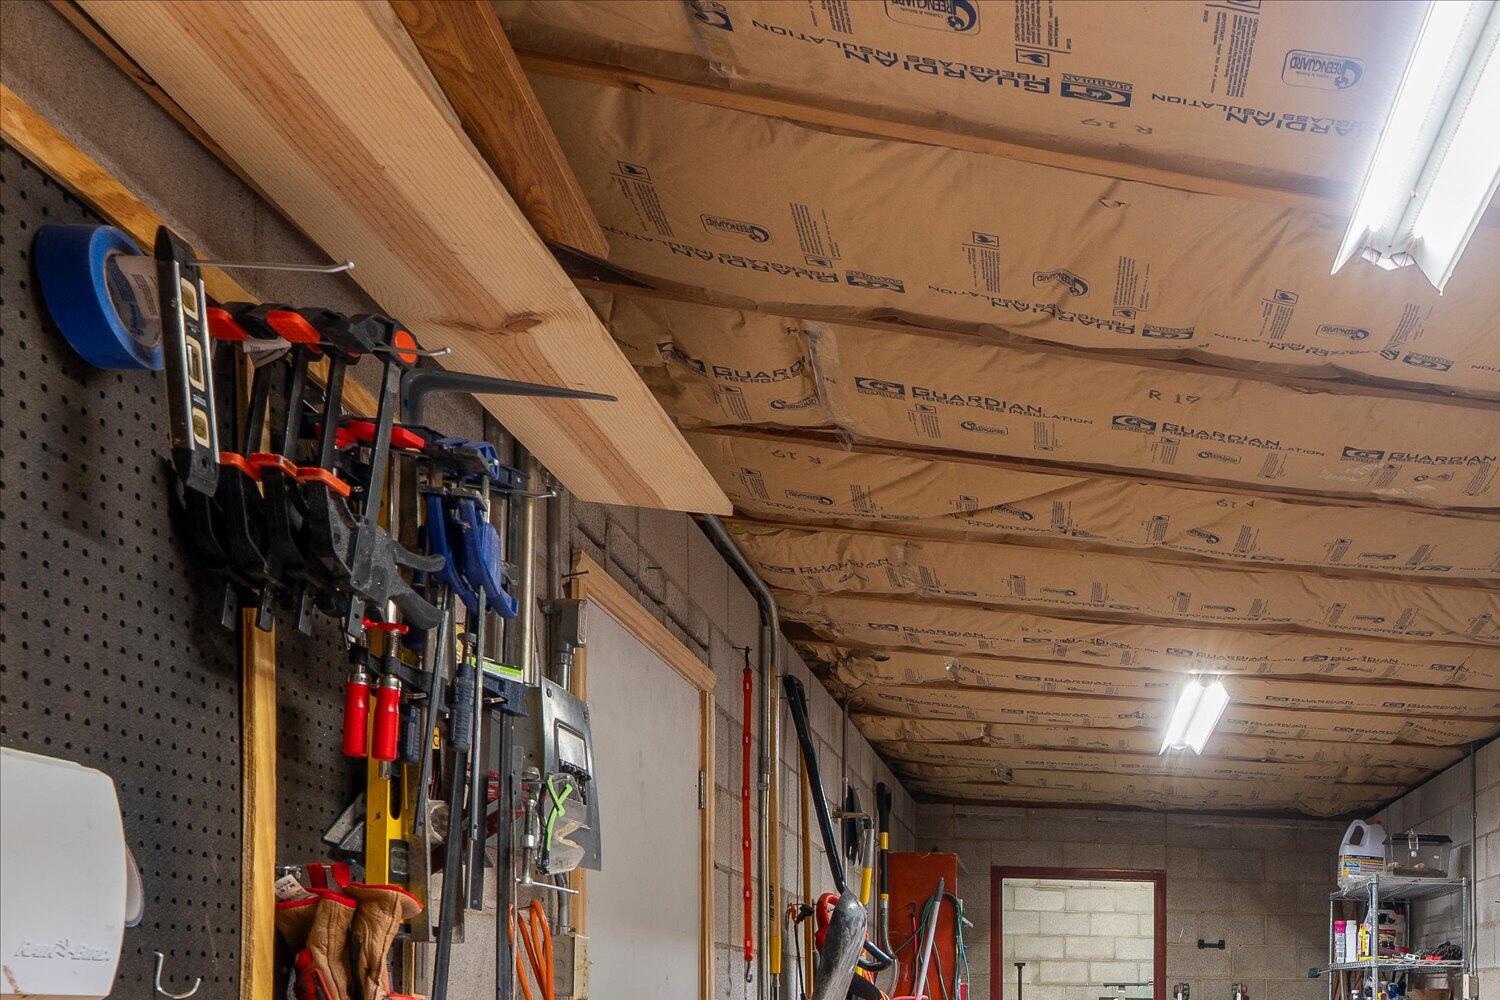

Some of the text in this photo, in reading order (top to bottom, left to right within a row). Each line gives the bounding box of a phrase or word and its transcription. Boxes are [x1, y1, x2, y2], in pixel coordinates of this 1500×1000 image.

[751, 20, 898, 62] INSULATION
[843, 50, 1050, 95] GUARDIAN
[906, 55, 1051, 84] FIBERGLASS
[1152, 93, 1276, 118] INSULATION
[1136, 125, 1153, 135] R
[671, 244, 839, 283] GUARDIAN
[991, 299, 1135, 334] GUARDIAN
[912, 387, 1044, 413] GUARDIAN
[1148, 389, 1161, 400] R
[1009, 408, 1093, 425] INSULATION
[1161, 423, 1281, 446] GUARDIAN
